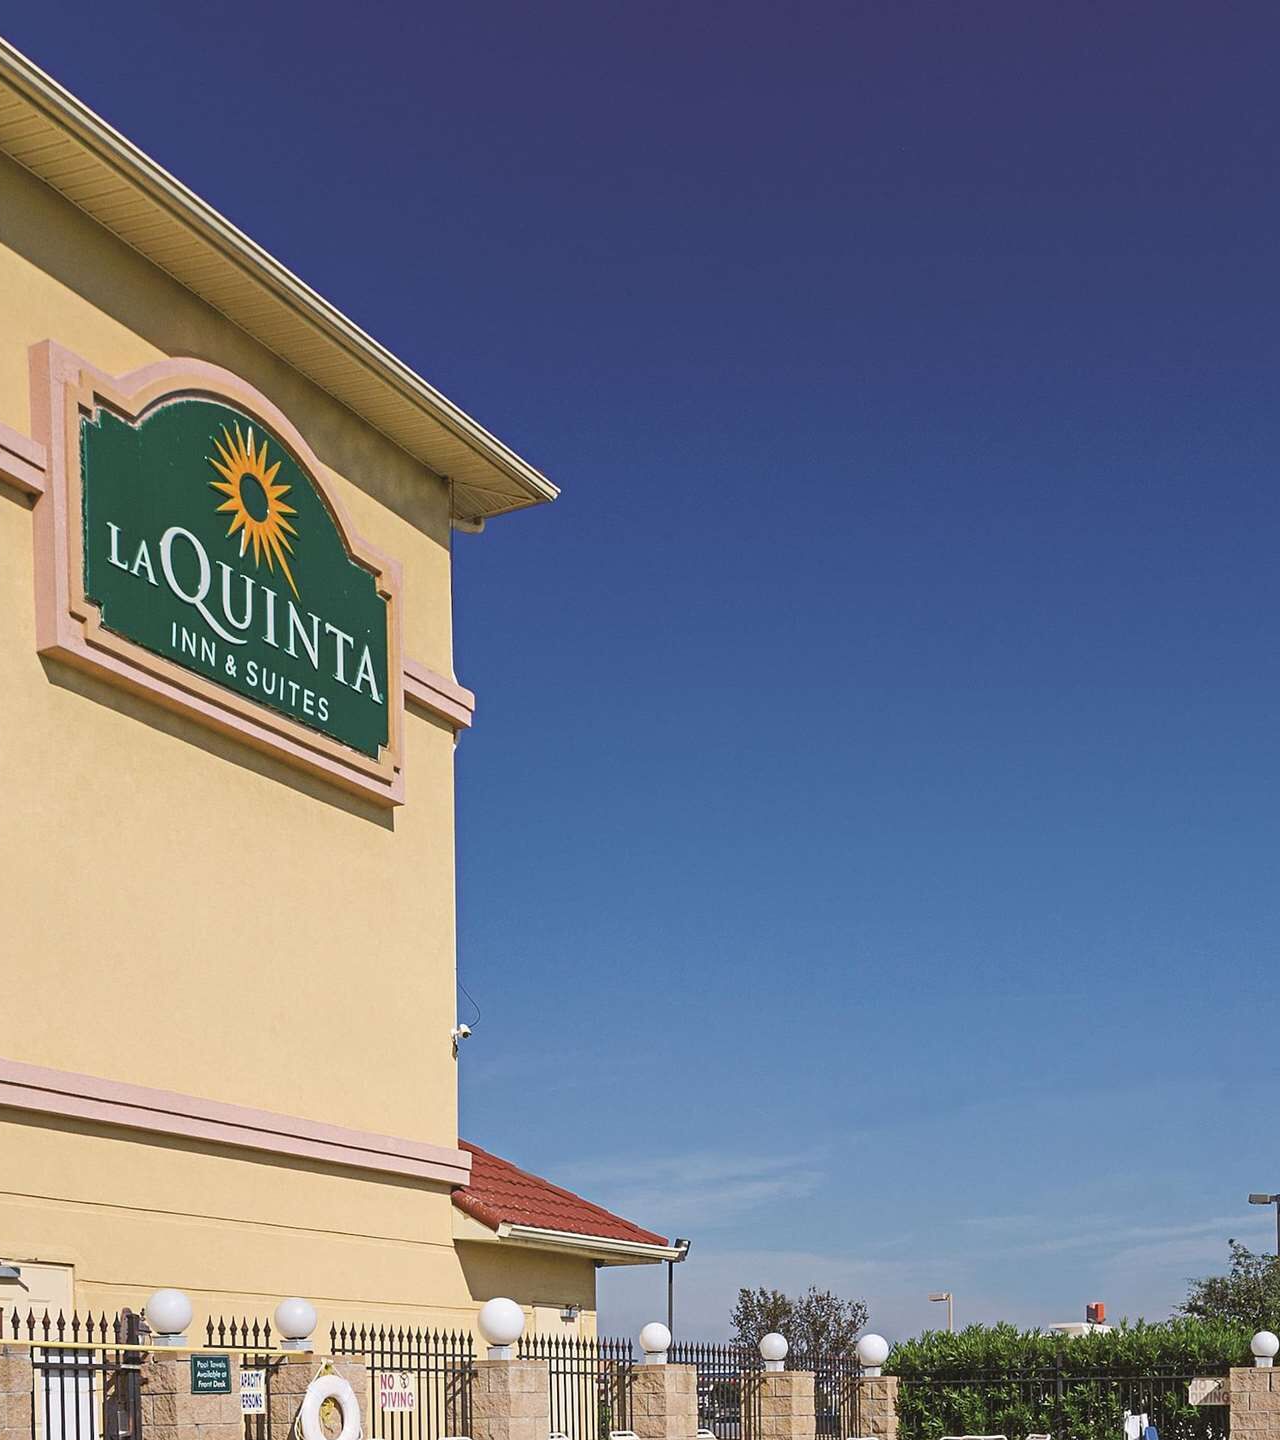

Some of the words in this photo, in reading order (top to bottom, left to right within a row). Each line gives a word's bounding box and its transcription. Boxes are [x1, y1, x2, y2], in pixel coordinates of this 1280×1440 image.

[106, 522, 158, 587] LA
[160, 526, 383, 705] QUINTA
[172, 622, 217, 668] INN
[225, 654, 238, 679] &
[246, 661, 330, 722] SUITES
[196, 1371, 221, 1379] Available
[240, 1373, 262, 1387] APACITY
[380, 1374, 395, 1390] NO
[198, 1380, 213, 1388] Front
[213, 1380, 226, 1388] Desk
[240, 1393, 263, 1408] ERSONS
[380, 1392, 414, 1408] DIVING
